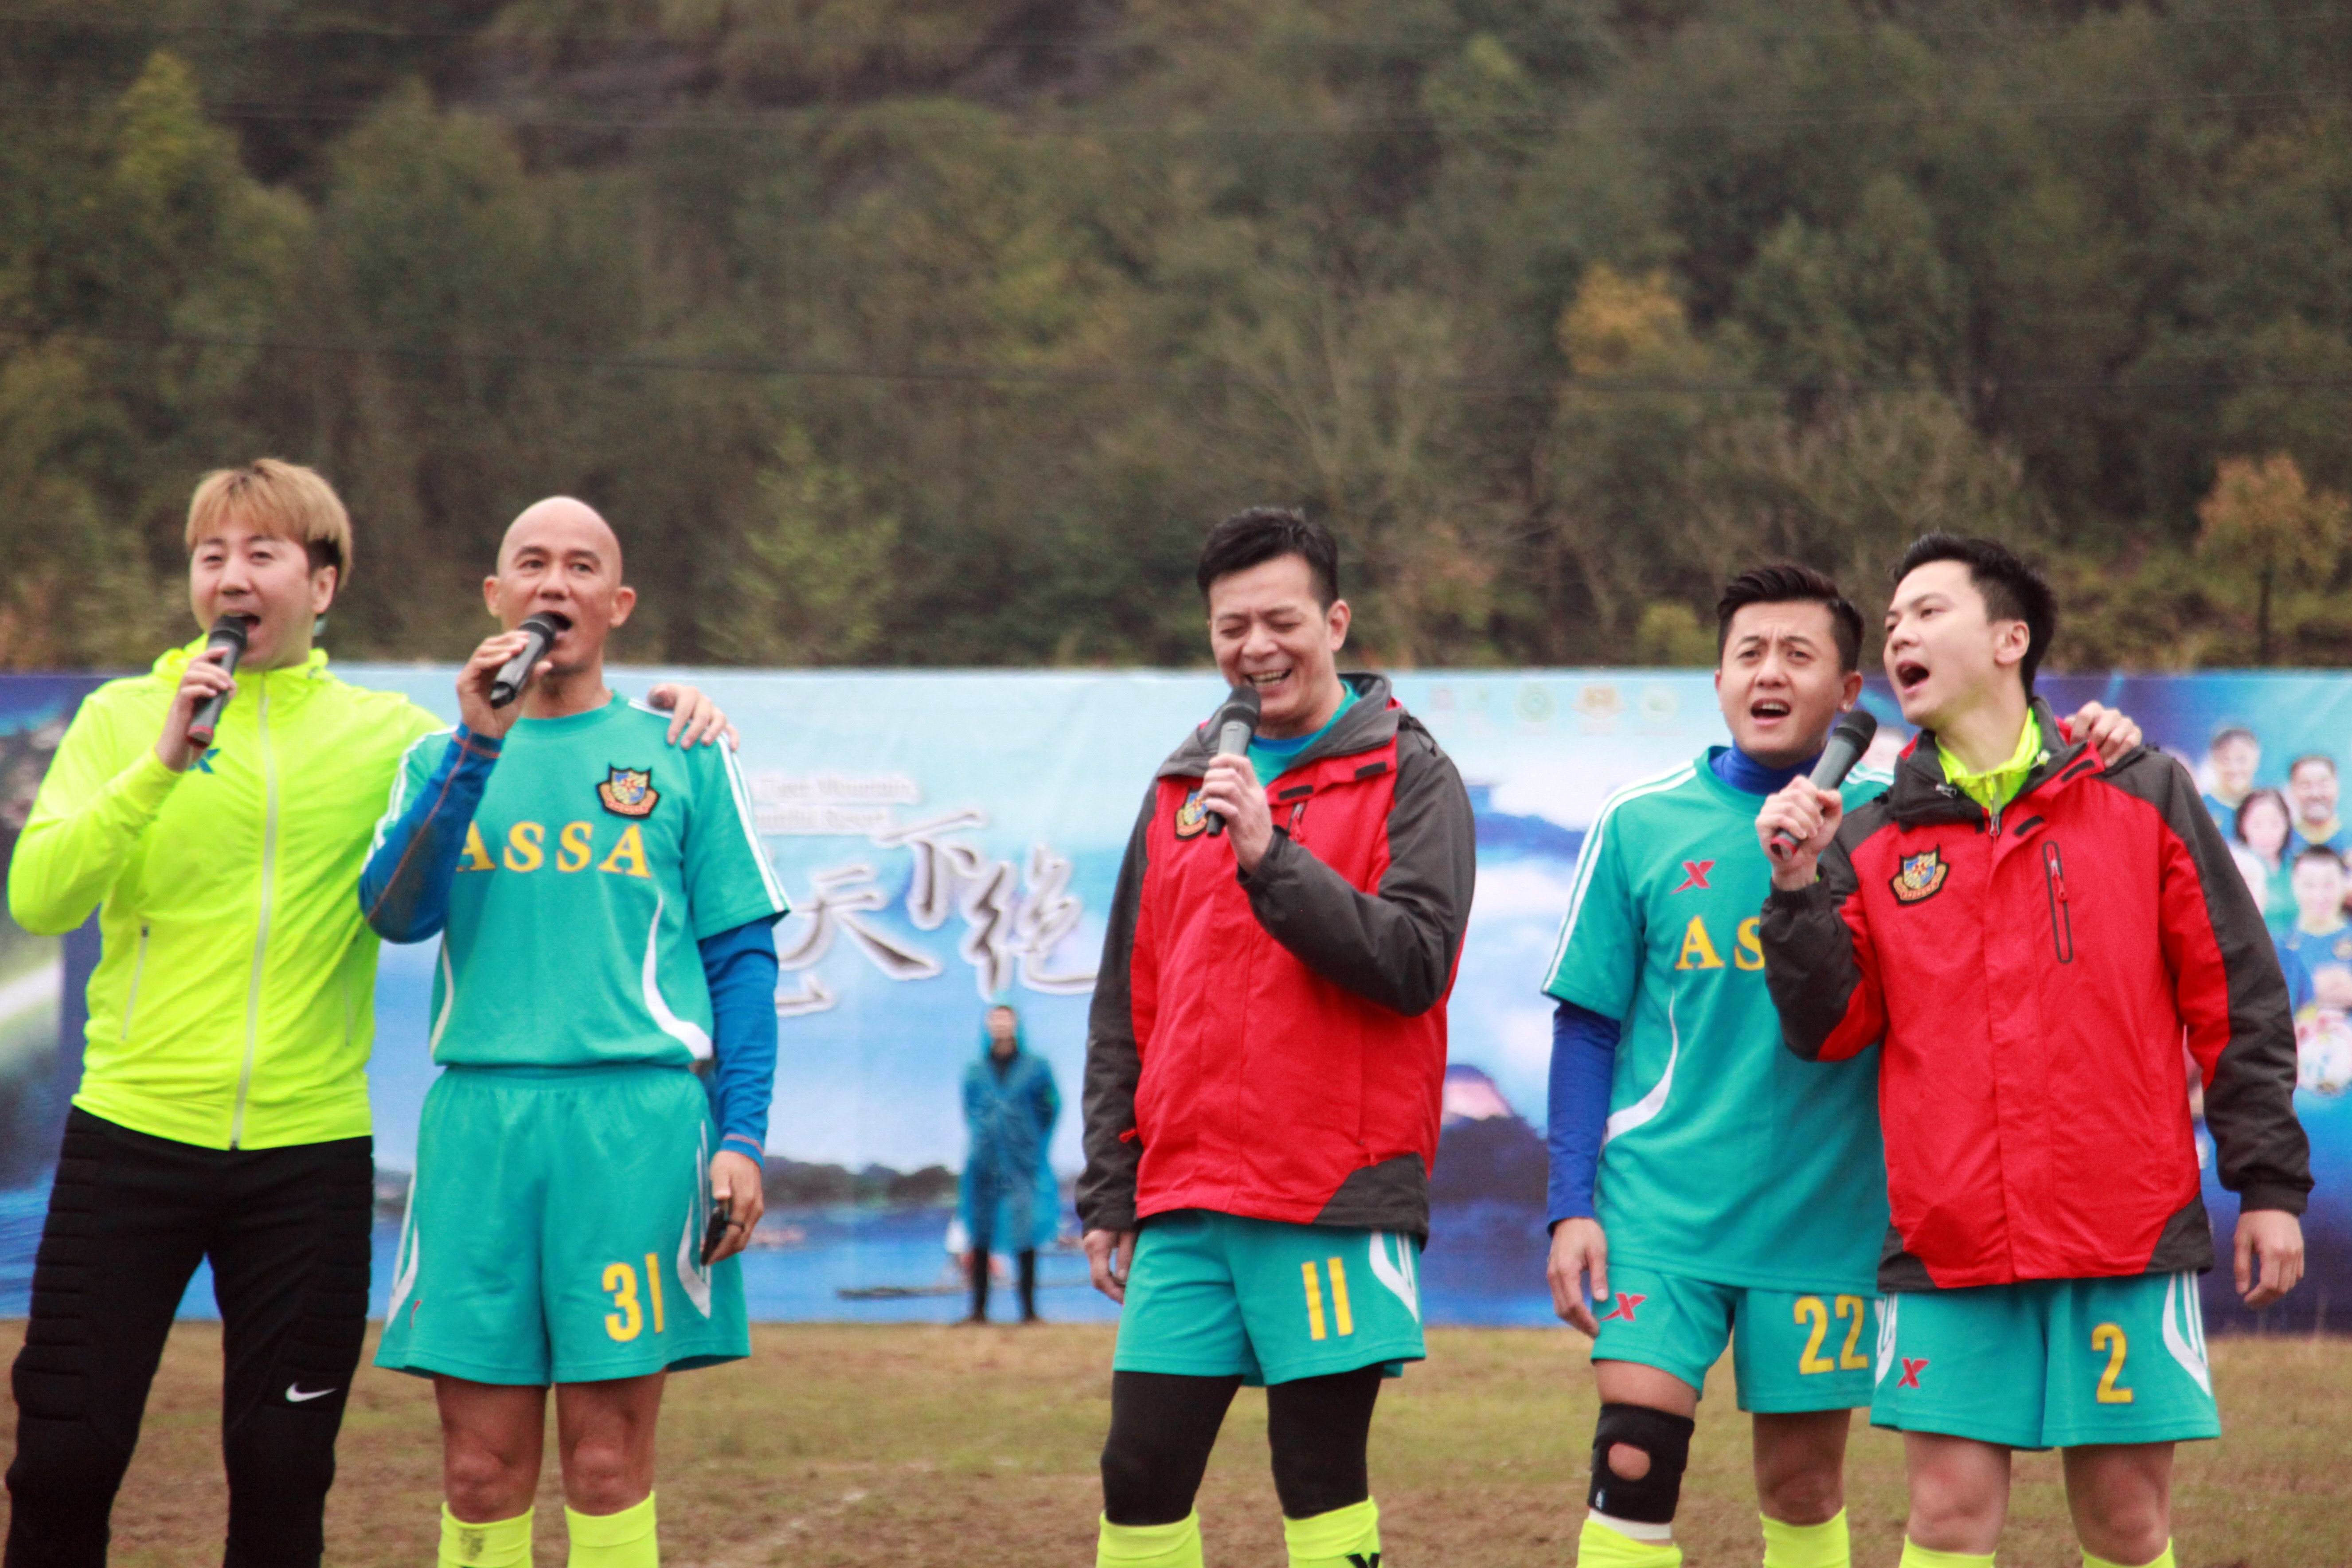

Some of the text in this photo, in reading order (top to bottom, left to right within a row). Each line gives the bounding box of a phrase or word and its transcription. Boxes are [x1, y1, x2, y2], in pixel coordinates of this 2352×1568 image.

[456, 820, 652, 878] ASSA
[602, 1252, 664, 1341] 31
[1301, 1257, 1354, 1341] 11
[1793, 1294, 1869, 1375] 22
[2091, 1322, 2133, 1404] 2
